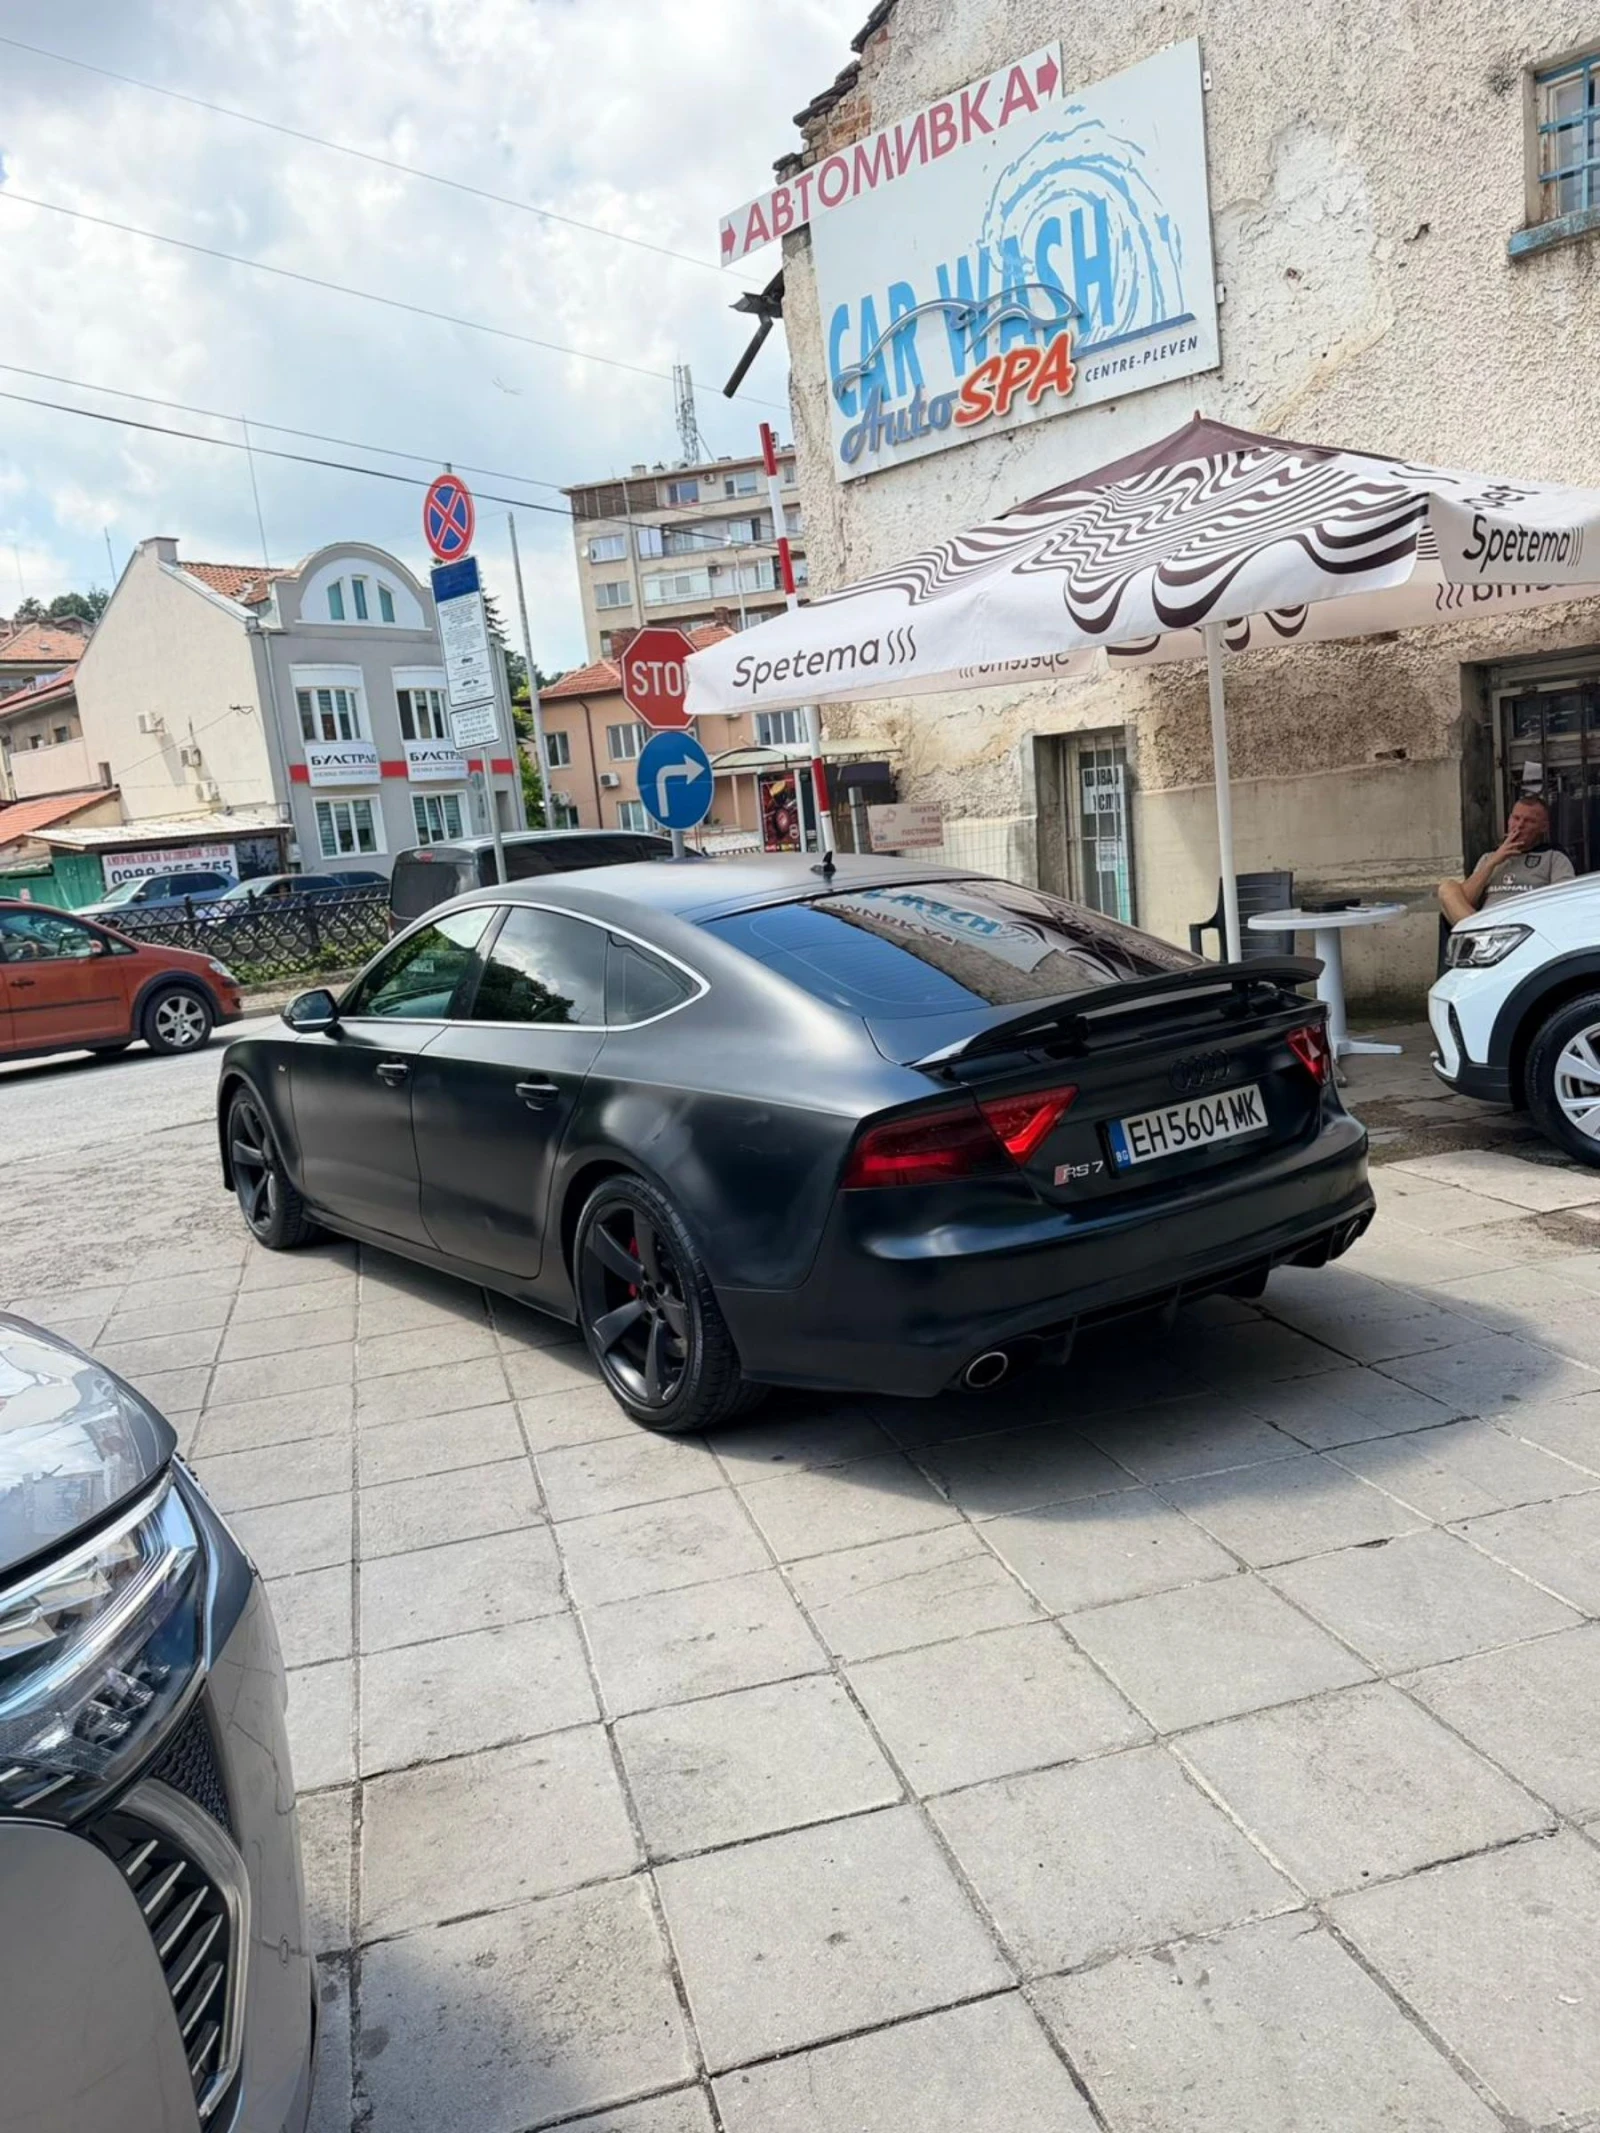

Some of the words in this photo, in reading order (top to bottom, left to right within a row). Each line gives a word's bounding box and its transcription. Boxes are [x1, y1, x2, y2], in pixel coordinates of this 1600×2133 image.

[743, 64, 1039, 253] АВТОМИВКА
[829, 281, 926, 418] CAR
[936, 197, 1114, 377] WASH
[1085, 336, 1198, 382] CENTRE-PLEVEN
[840, 384, 958, 464] Auto
[953, 330, 1076, 427] SPA
[1462, 513, 1571, 574] Spetema
[732, 638, 880, 694] Spetema
[1115, 1150, 1129, 1163] BG
